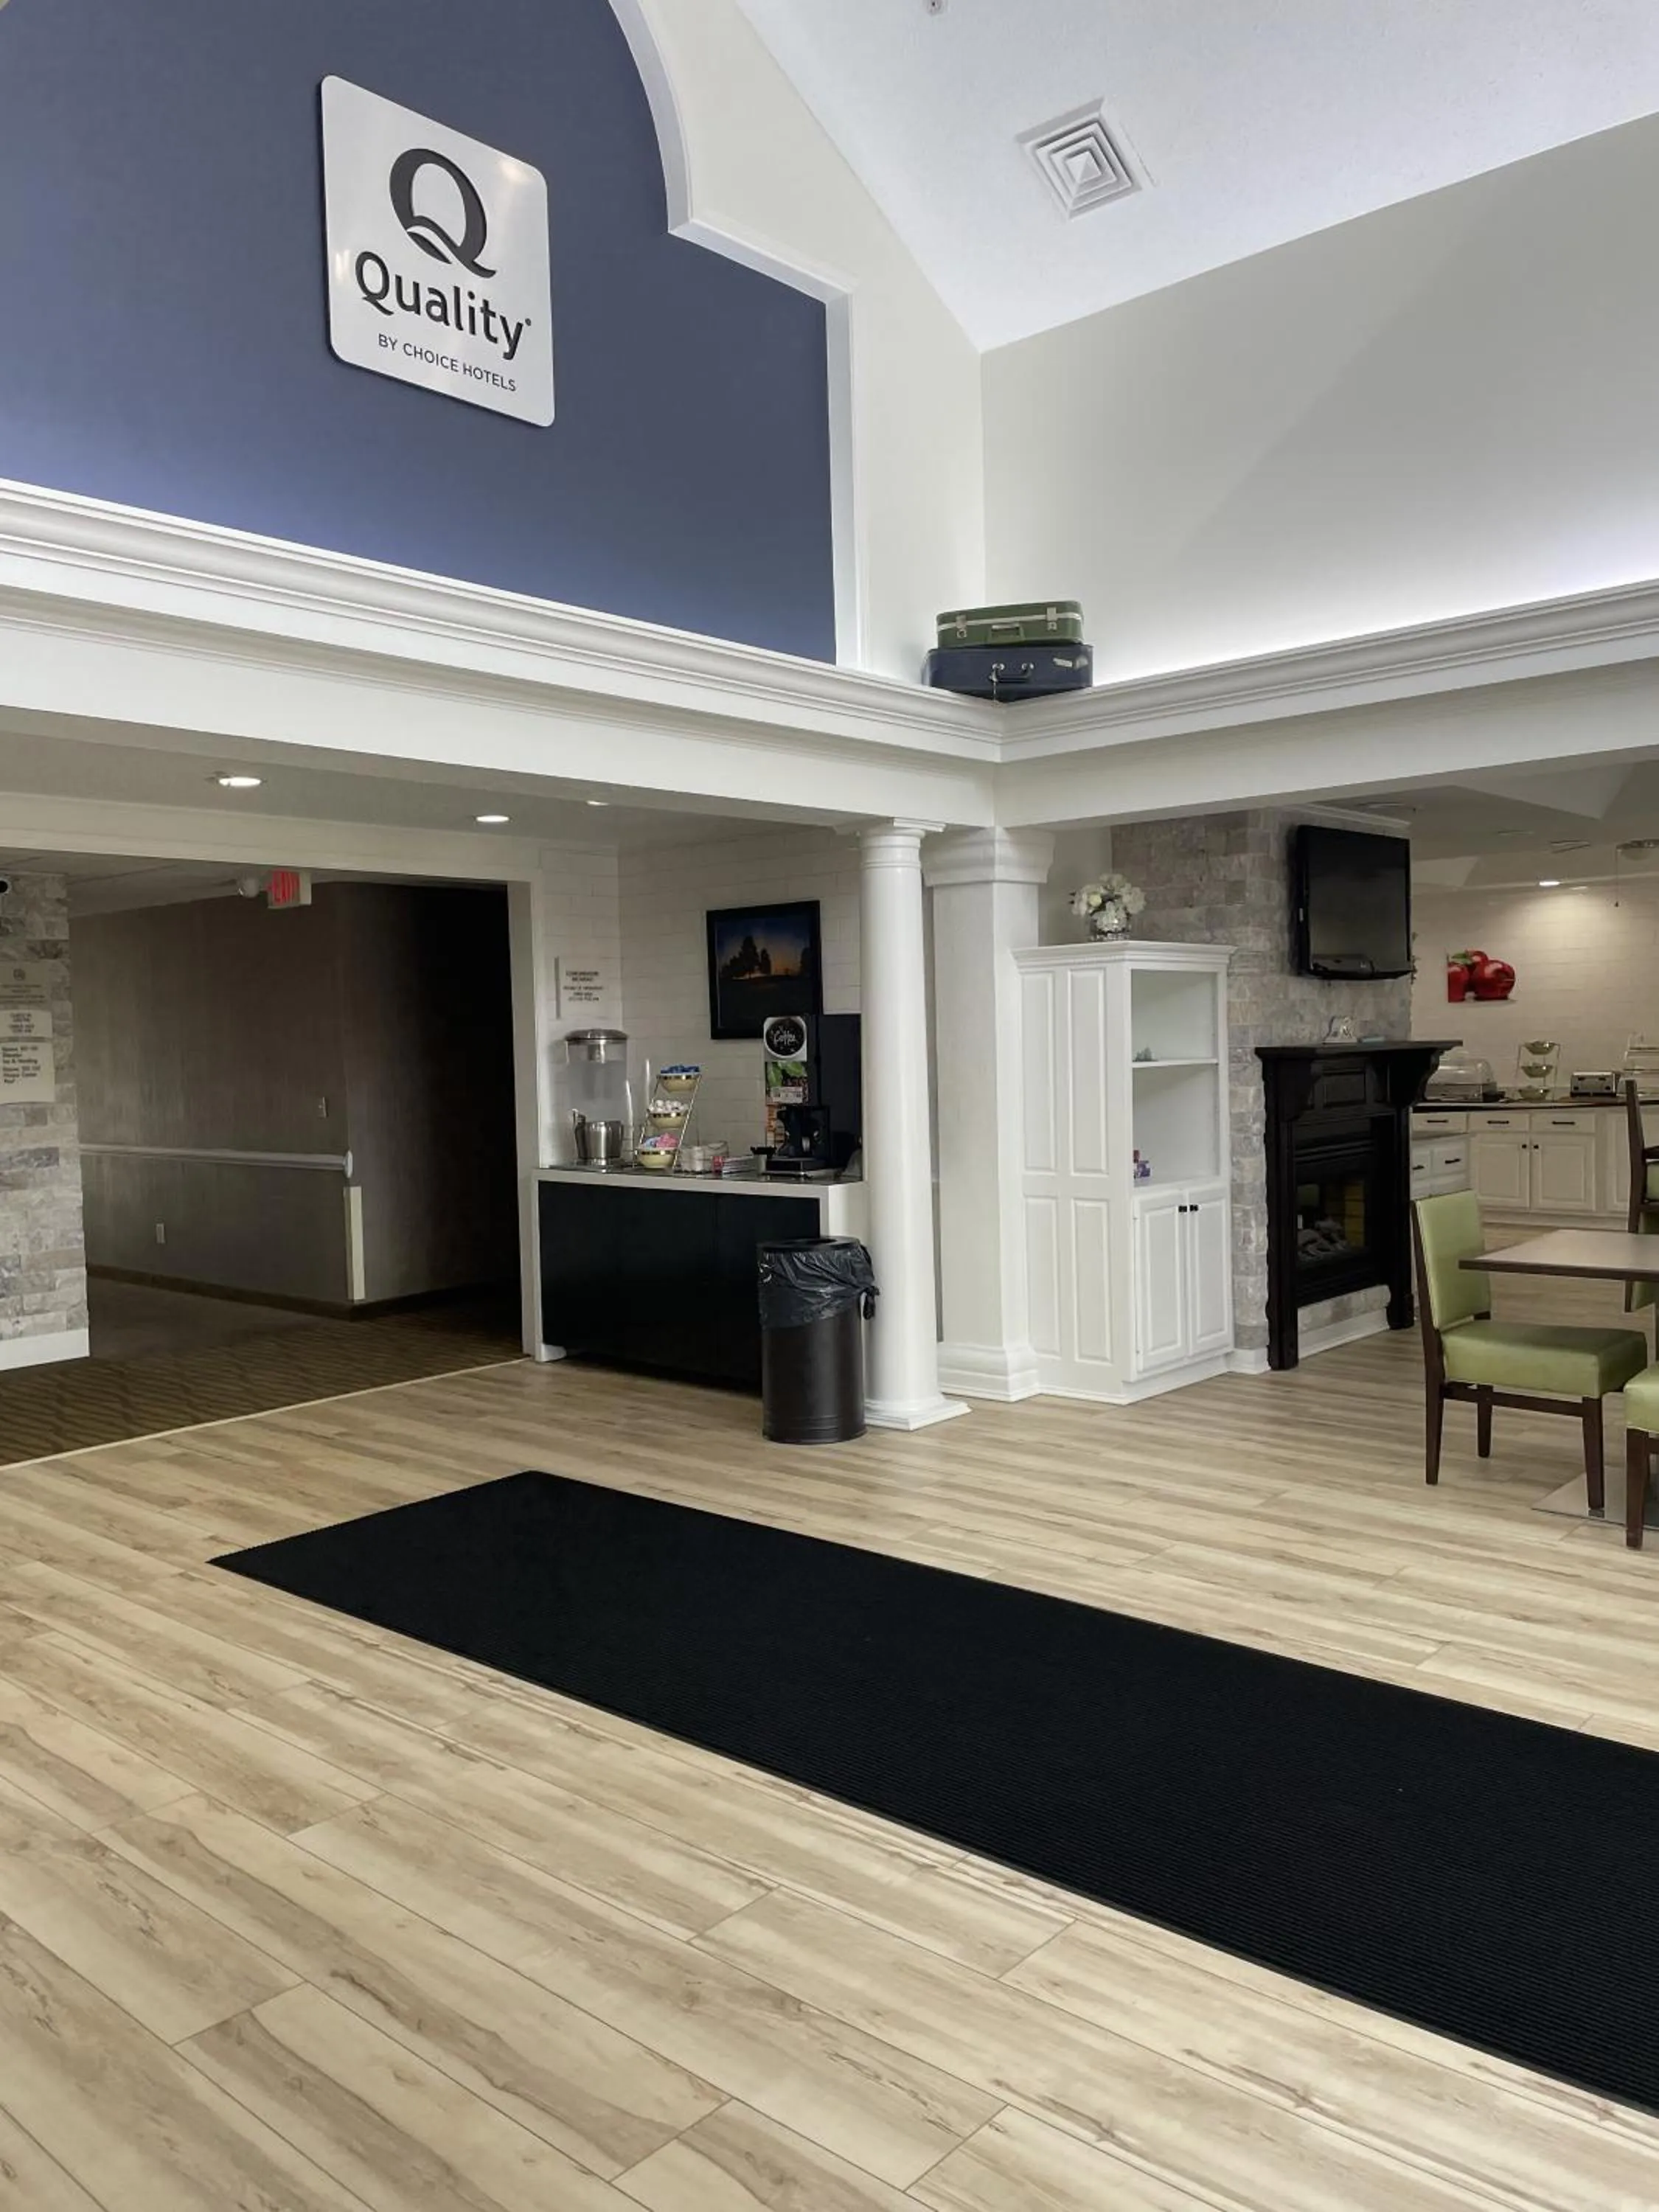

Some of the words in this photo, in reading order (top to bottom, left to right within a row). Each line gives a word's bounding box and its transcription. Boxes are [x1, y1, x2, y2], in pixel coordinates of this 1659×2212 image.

[389, 148, 496, 279] Q
[355, 251, 524, 361] Quality
[378, 333, 398, 351] BY
[403, 342, 459, 373] CHOICE
[462, 363, 516, 392] HOTELS
